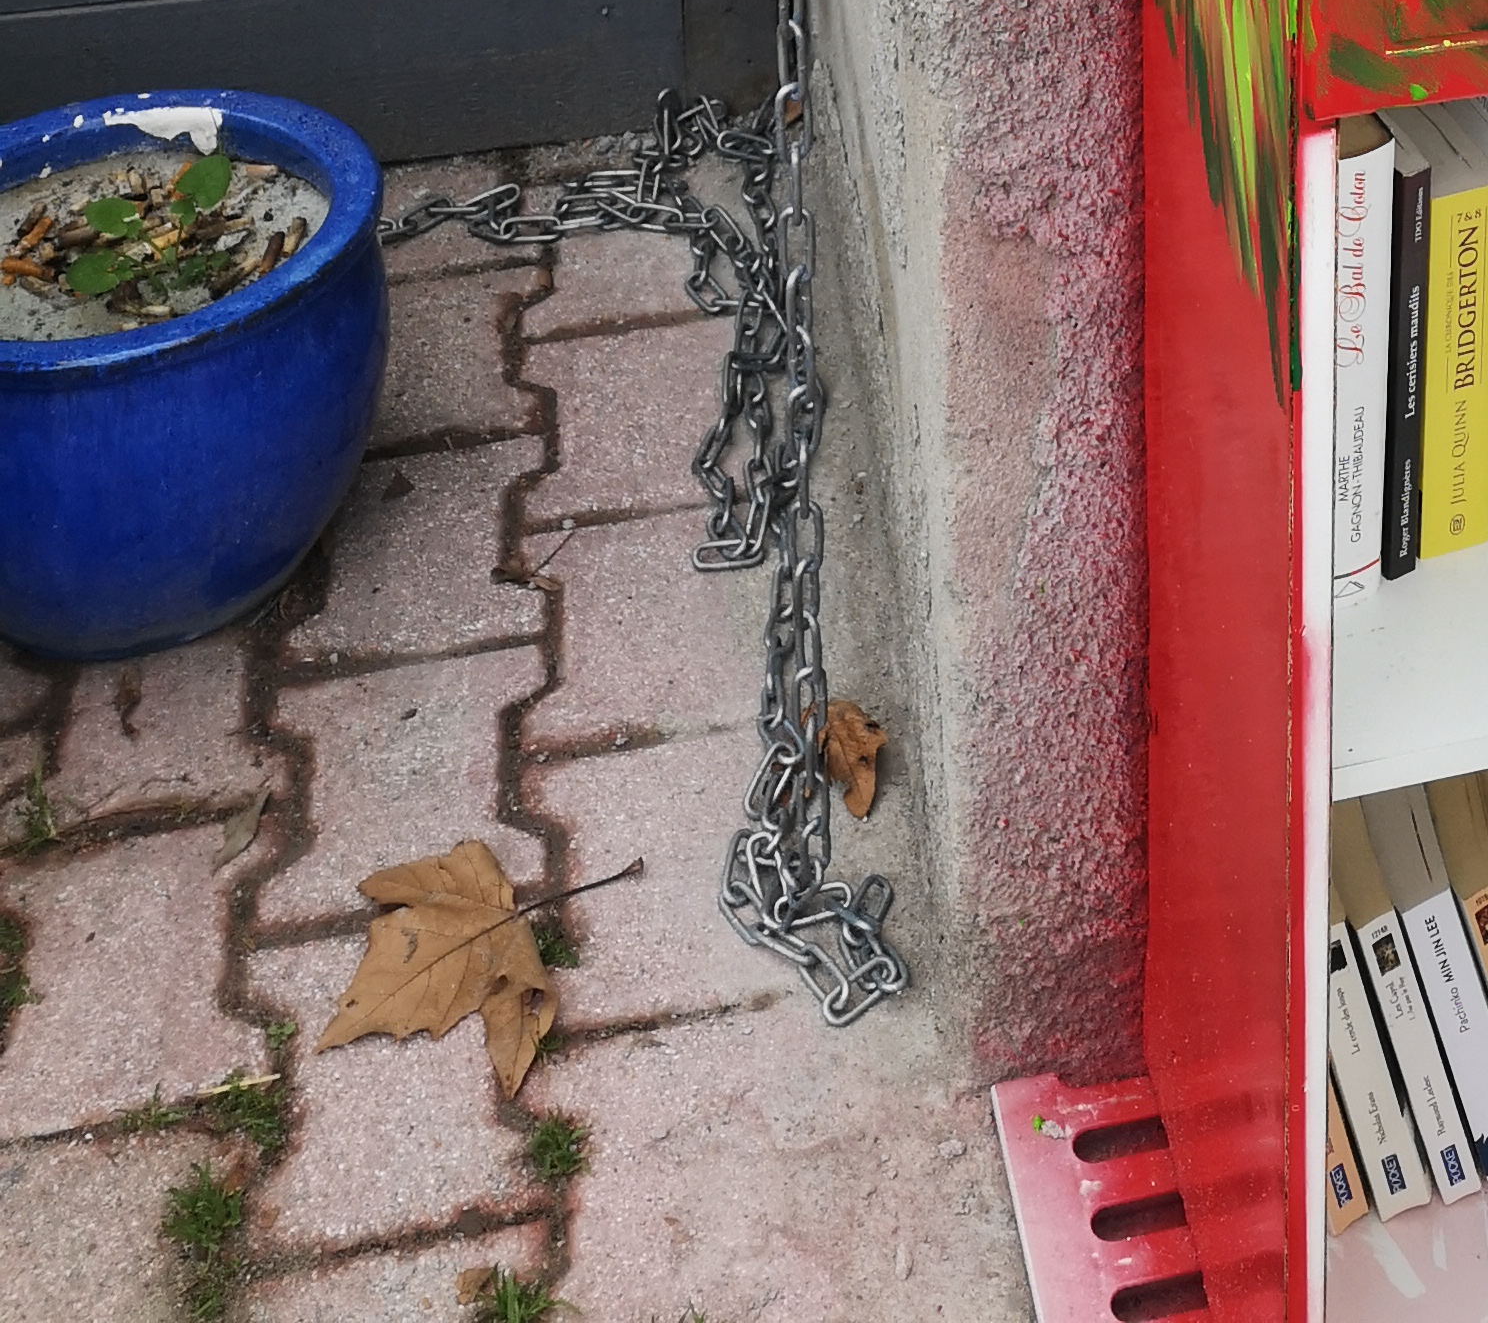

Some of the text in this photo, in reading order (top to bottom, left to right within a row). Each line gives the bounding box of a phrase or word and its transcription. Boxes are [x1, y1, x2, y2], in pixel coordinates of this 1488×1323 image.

[1413, 222, 1423, 244] TDO
[1336, 170, 1371, 368] Le Bal de Coton
[1452, 225, 1480, 391] BRIDGERTON
[1403, 285, 1421, 419] Les cerisiers maudits
[1449, 399, 1470, 459] QUINN
[1337, 455, 1351, 502] MARTHE
[1349, 405, 1365, 544] GAGNON-THIBAUDEAU
[1449, 460, 1467, 506] JULIA
[1424, 914, 1471, 1034] Pachinko MIN JIN LEE
[1351, 1040, 1361, 1055] Le
[1331, 1166, 1350, 1209] POCKET
[1385, 1154, 1404, 1195] POCKET
[1443, 1147, 1463, 1187] POCKET
